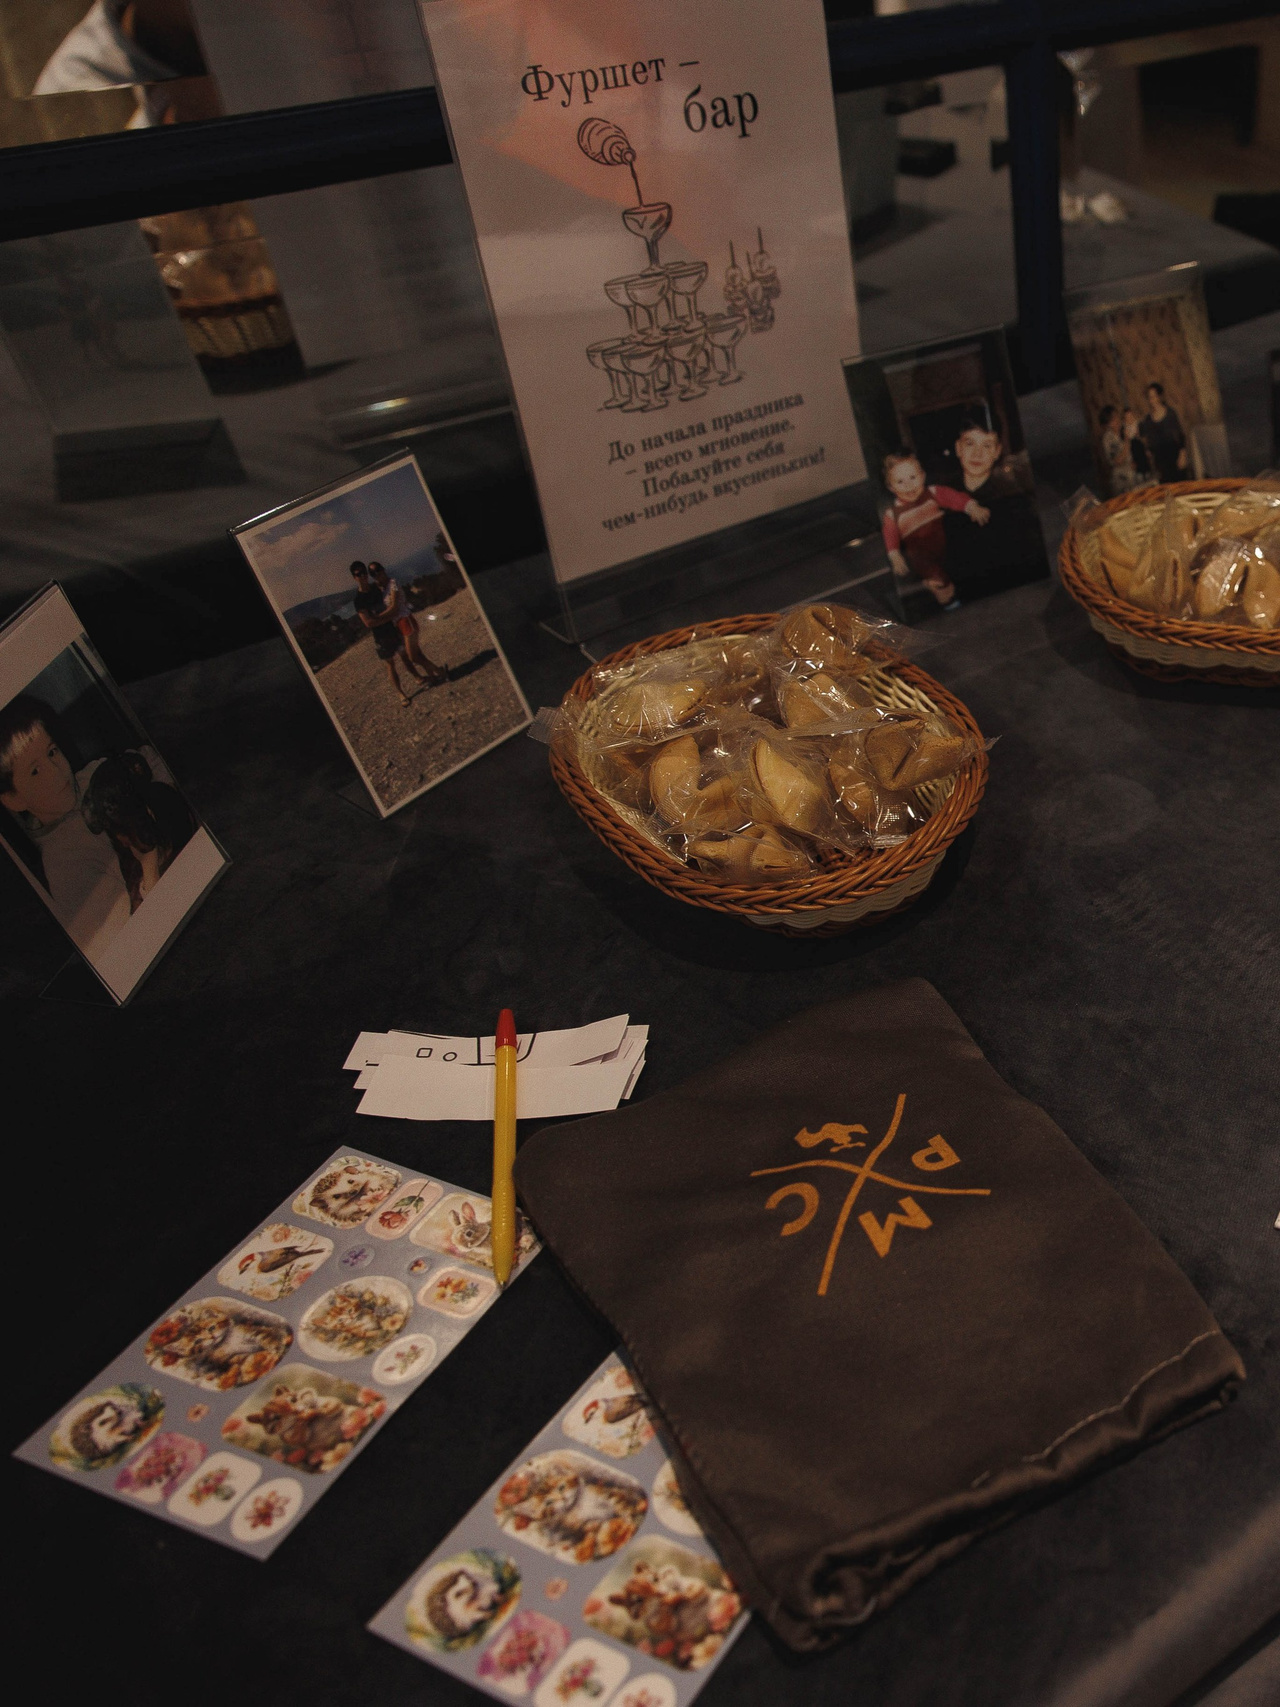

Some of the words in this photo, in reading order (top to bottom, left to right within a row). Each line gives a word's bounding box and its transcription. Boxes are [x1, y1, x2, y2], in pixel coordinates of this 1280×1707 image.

[520, 56, 667, 108] Фуршет
[684, 85, 759, 138] бар
[608, 440, 636, 464] До
[641, 419, 707, 452] начала
[712, 393, 805, 433] праздника
[644, 449, 693, 475] всего
[698, 418, 796, 458] мгновение.
[602, 487, 709, 532] чем-нибудь
[713, 446, 826, 498] вкусненьким!
[642, 452, 742, 498] Побалуйте
[746, 440, 785, 464] себя
